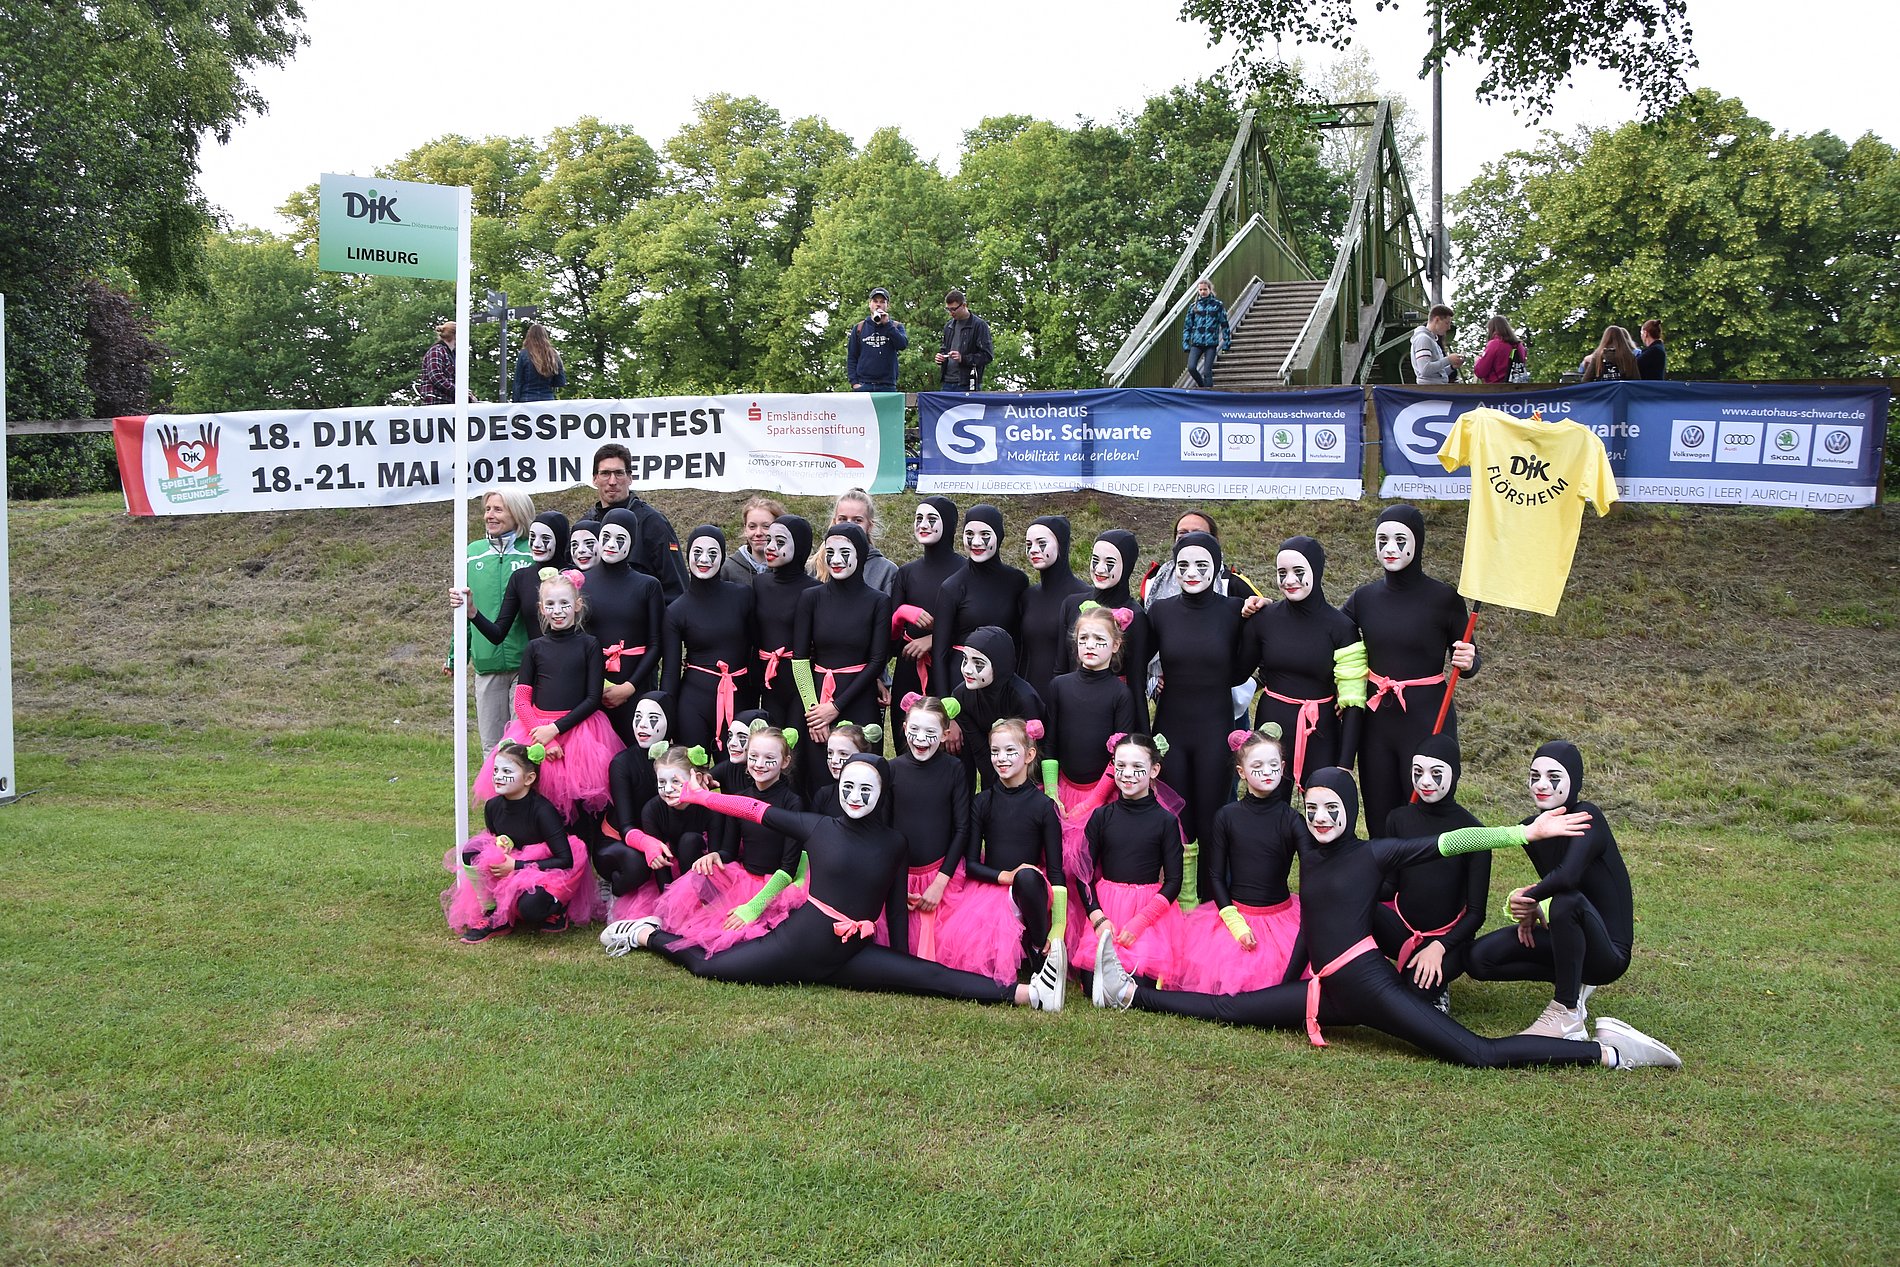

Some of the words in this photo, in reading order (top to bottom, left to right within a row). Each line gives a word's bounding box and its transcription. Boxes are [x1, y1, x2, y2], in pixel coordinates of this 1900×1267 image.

[347, 246, 419, 265] LIMBURG
[767, 410, 837, 421] Emsländische
[1004, 403, 1088, 419] Autohaus
[1222, 410, 1346, 420] www.autohaus-schwarte.de
[1722, 407, 1866, 420] www.autohaus-schwarte.de
[248, 423, 300, 451] 18.
[313, 418, 376, 448] DJK
[389, 408, 725, 445] BUNDESSPORTFEST
[767, 425, 865, 437] Sparkassenstiftung
[1005, 424, 1056, 441] Gebr.
[1061, 424, 1152, 441] Schwarte
[1007, 449, 1060, 462] Mobilität
[1063, 452, 1085, 462] neu
[1090, 450, 1140, 462] erleben!
[1183, 451, 1218, 459] Volkswagen
[1672, 450, 1711, 459] Volkswagen
[252, 463, 364, 493] 18.-21.
[378, 461, 440, 487] MAI
[548, 457, 581, 482] IN
[631, 451, 726, 481] EPPEN
[161, 477, 195, 490] SPIELE
[933, 481, 974, 491] MEPPEN
[981, 479, 1032, 491] LÜBBECKE
[1107, 481, 1145, 493] BÜNDE
[1153, 483, 1215, 495] PAPENBURG
[1223, 484, 1249, 495] LEER
[1256, 484, 1297, 496] AURICH
[1305, 485, 1345, 496] EMDEN
[1487, 465, 1569, 507] FLÖRSHEIM
[171, 488, 218, 502] FREUNDEN
[1393, 482, 1437, 494] MEPPEN
[1638, 485, 1705, 498] PAPENBURG
[1714, 487, 1742, 499] LEER
[1751, 488, 1797, 501] AURICH
[1808, 491, 1855, 504] EMDEN
